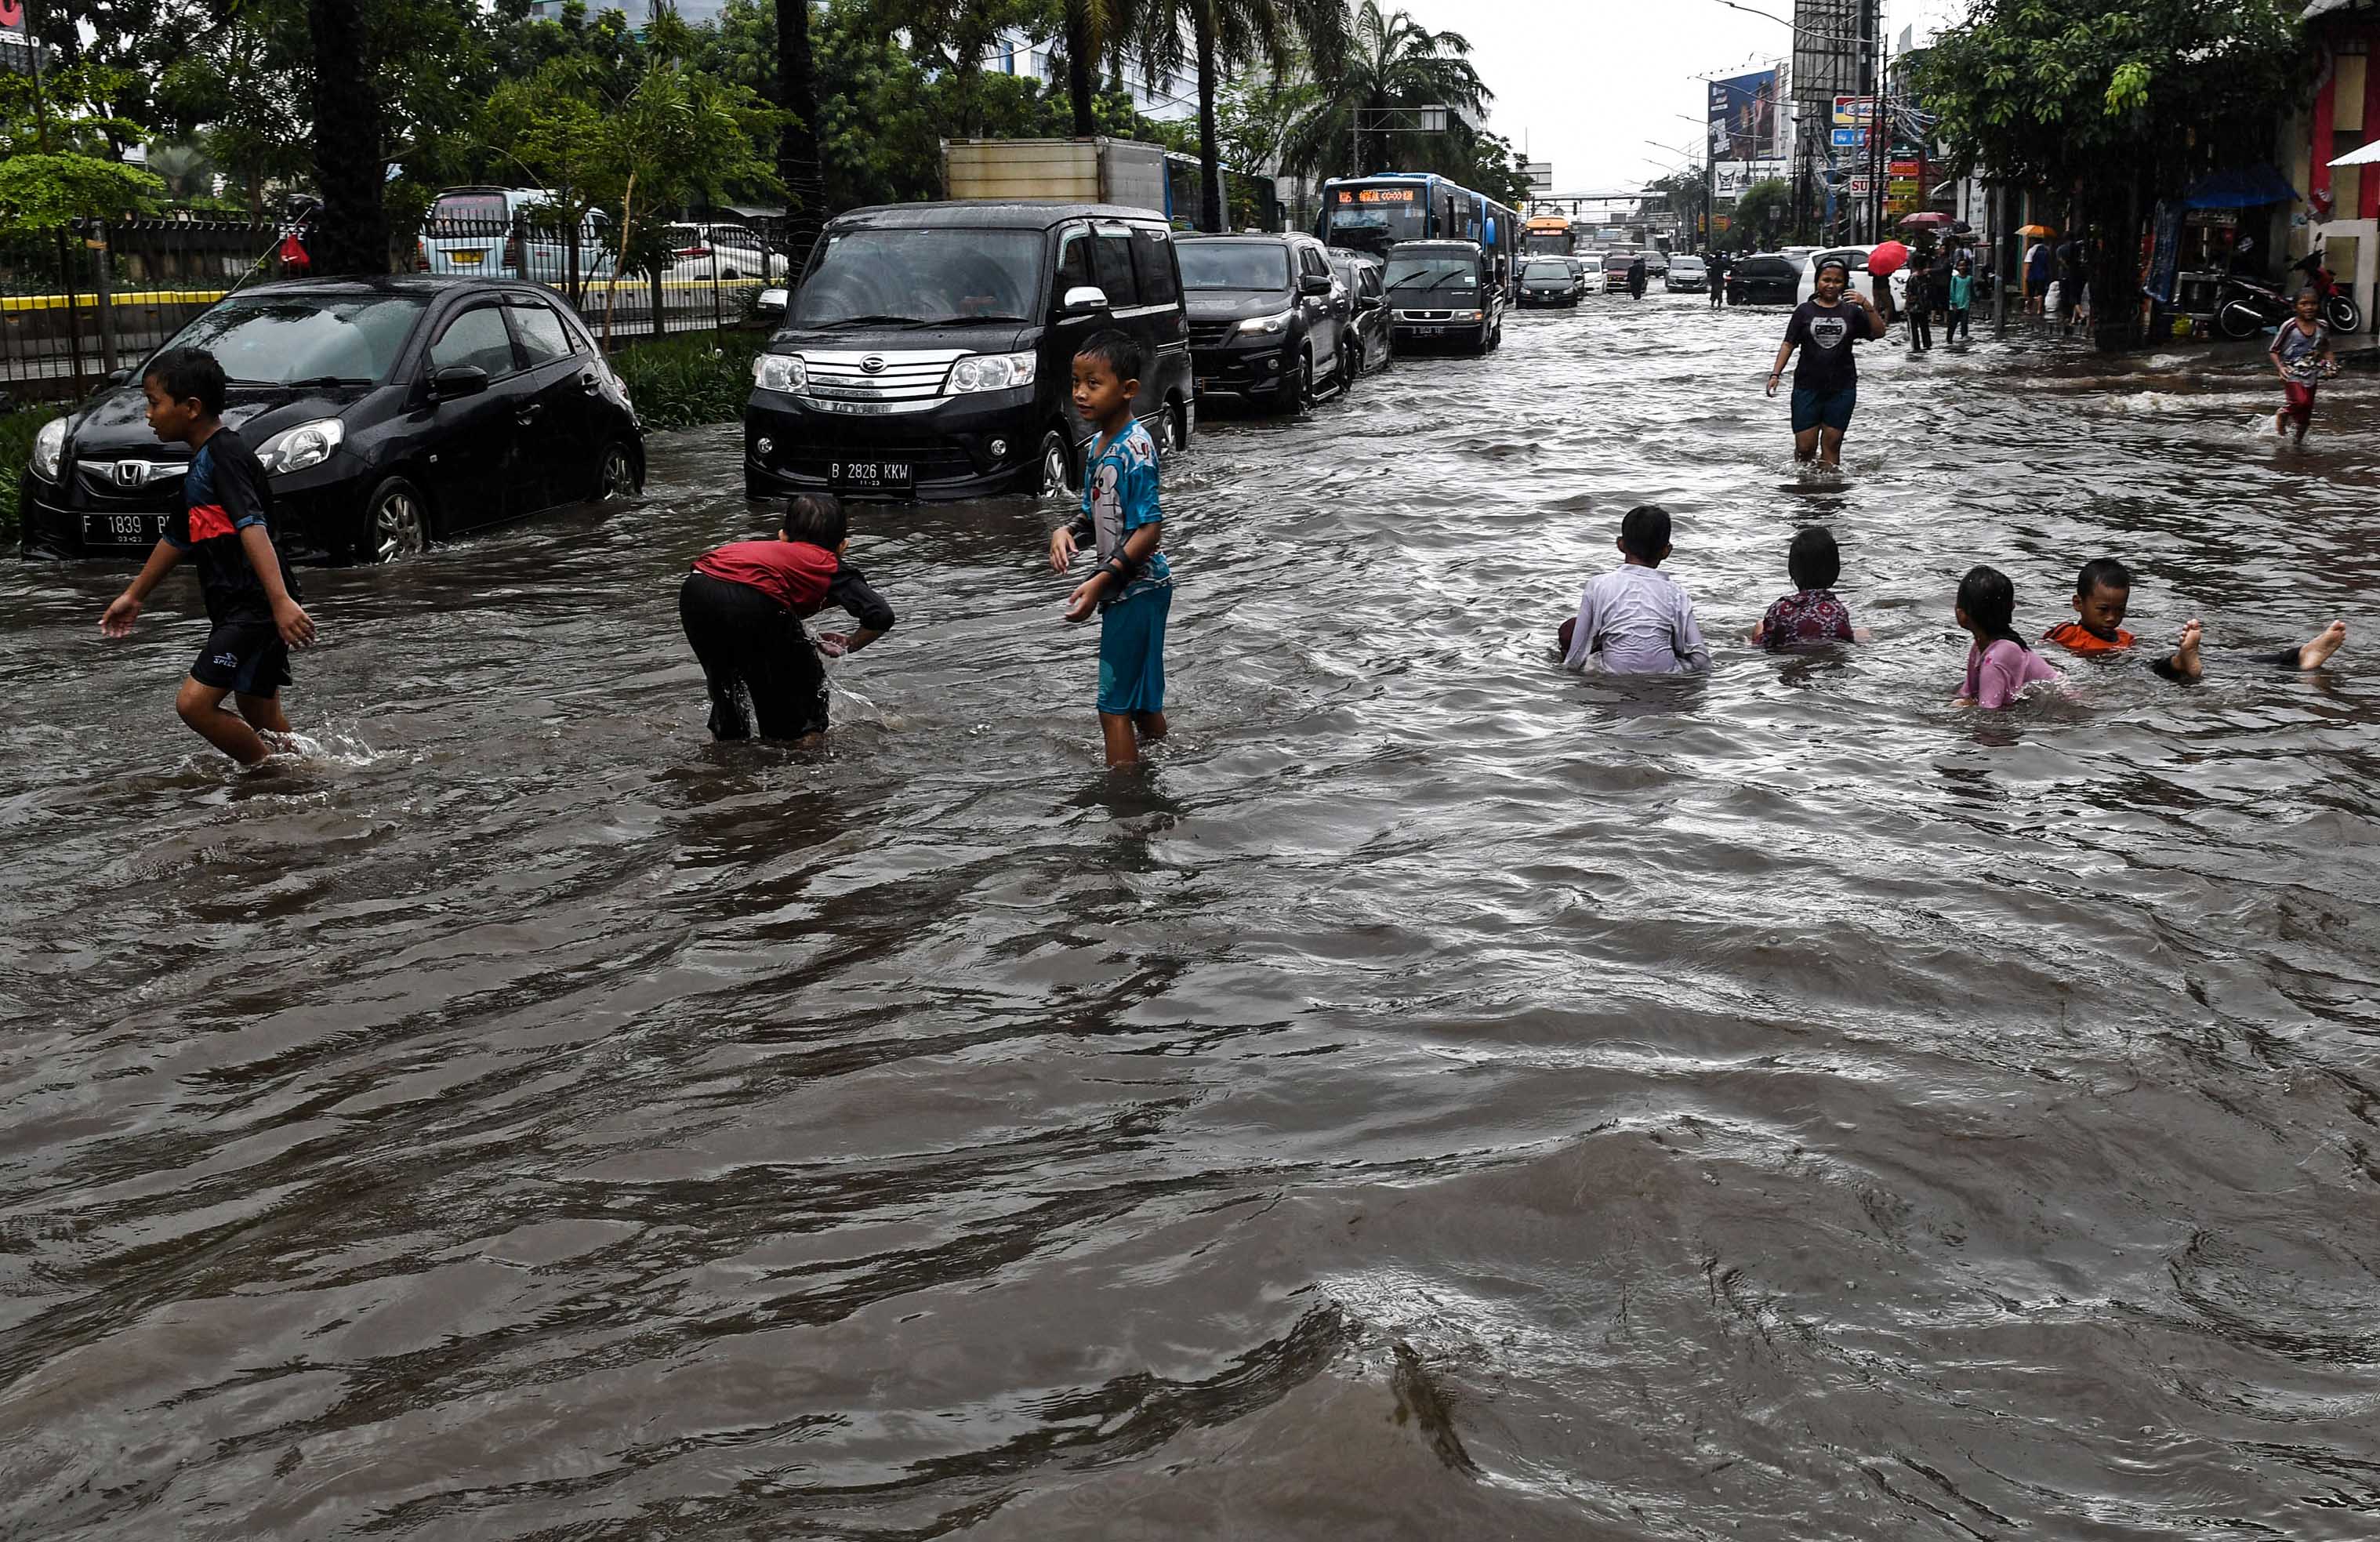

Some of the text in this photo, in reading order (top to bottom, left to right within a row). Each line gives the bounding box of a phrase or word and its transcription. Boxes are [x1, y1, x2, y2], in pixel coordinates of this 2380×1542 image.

[832, 463, 908, 479] B 2826 KKW
[83, 515, 170, 534] F 1839 P
